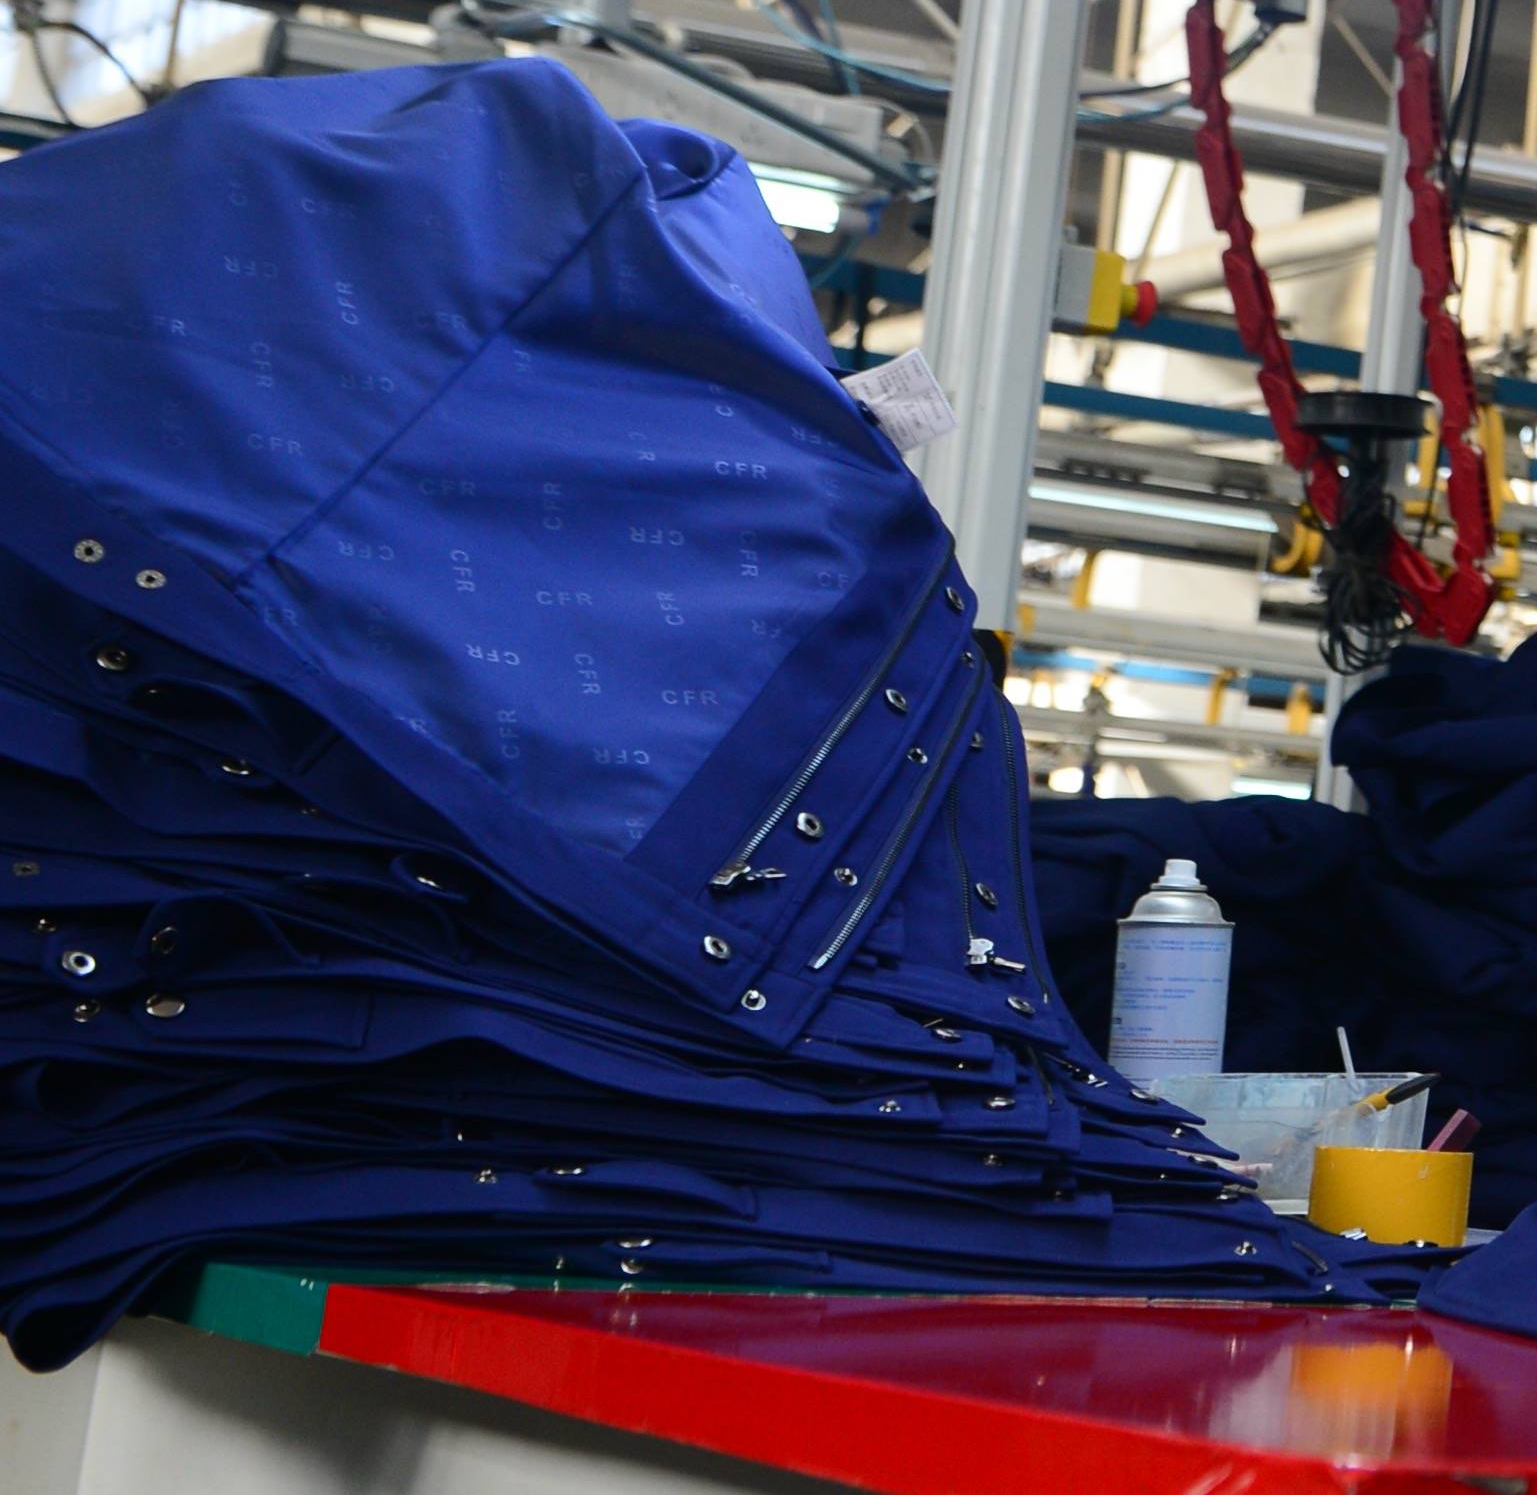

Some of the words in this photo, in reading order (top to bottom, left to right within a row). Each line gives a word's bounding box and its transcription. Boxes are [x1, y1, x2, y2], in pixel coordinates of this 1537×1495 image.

[223, 255, 278, 279] CFR
[334, 280, 359, 326] CFR
[250, 341, 275, 388] CFR
[341, 372, 396, 394] CFR
[247, 432, 304, 458] CFR
[628, 431, 657, 462] CR
[714, 459, 768, 480] CFR
[419, 479, 477, 498] CFR
[629, 526, 685, 547] CFR
[337, 540, 395, 562] CFR
[740, 530, 760, 578] CFR
[450, 548, 476, 594] CFR
[535, 590, 594, 606] CFR
[656, 591, 685, 627] CFR
[263, 606, 299, 627] FR
[750, 618, 783, 640] FR
[465, 643, 522, 666] CFR
[574, 653, 601, 695] CFR
[661, 689, 719, 706] CFR
[497, 708, 522, 760] CFR
[592, 748, 650, 766] CFR
[626, 816, 646, 840] FR
